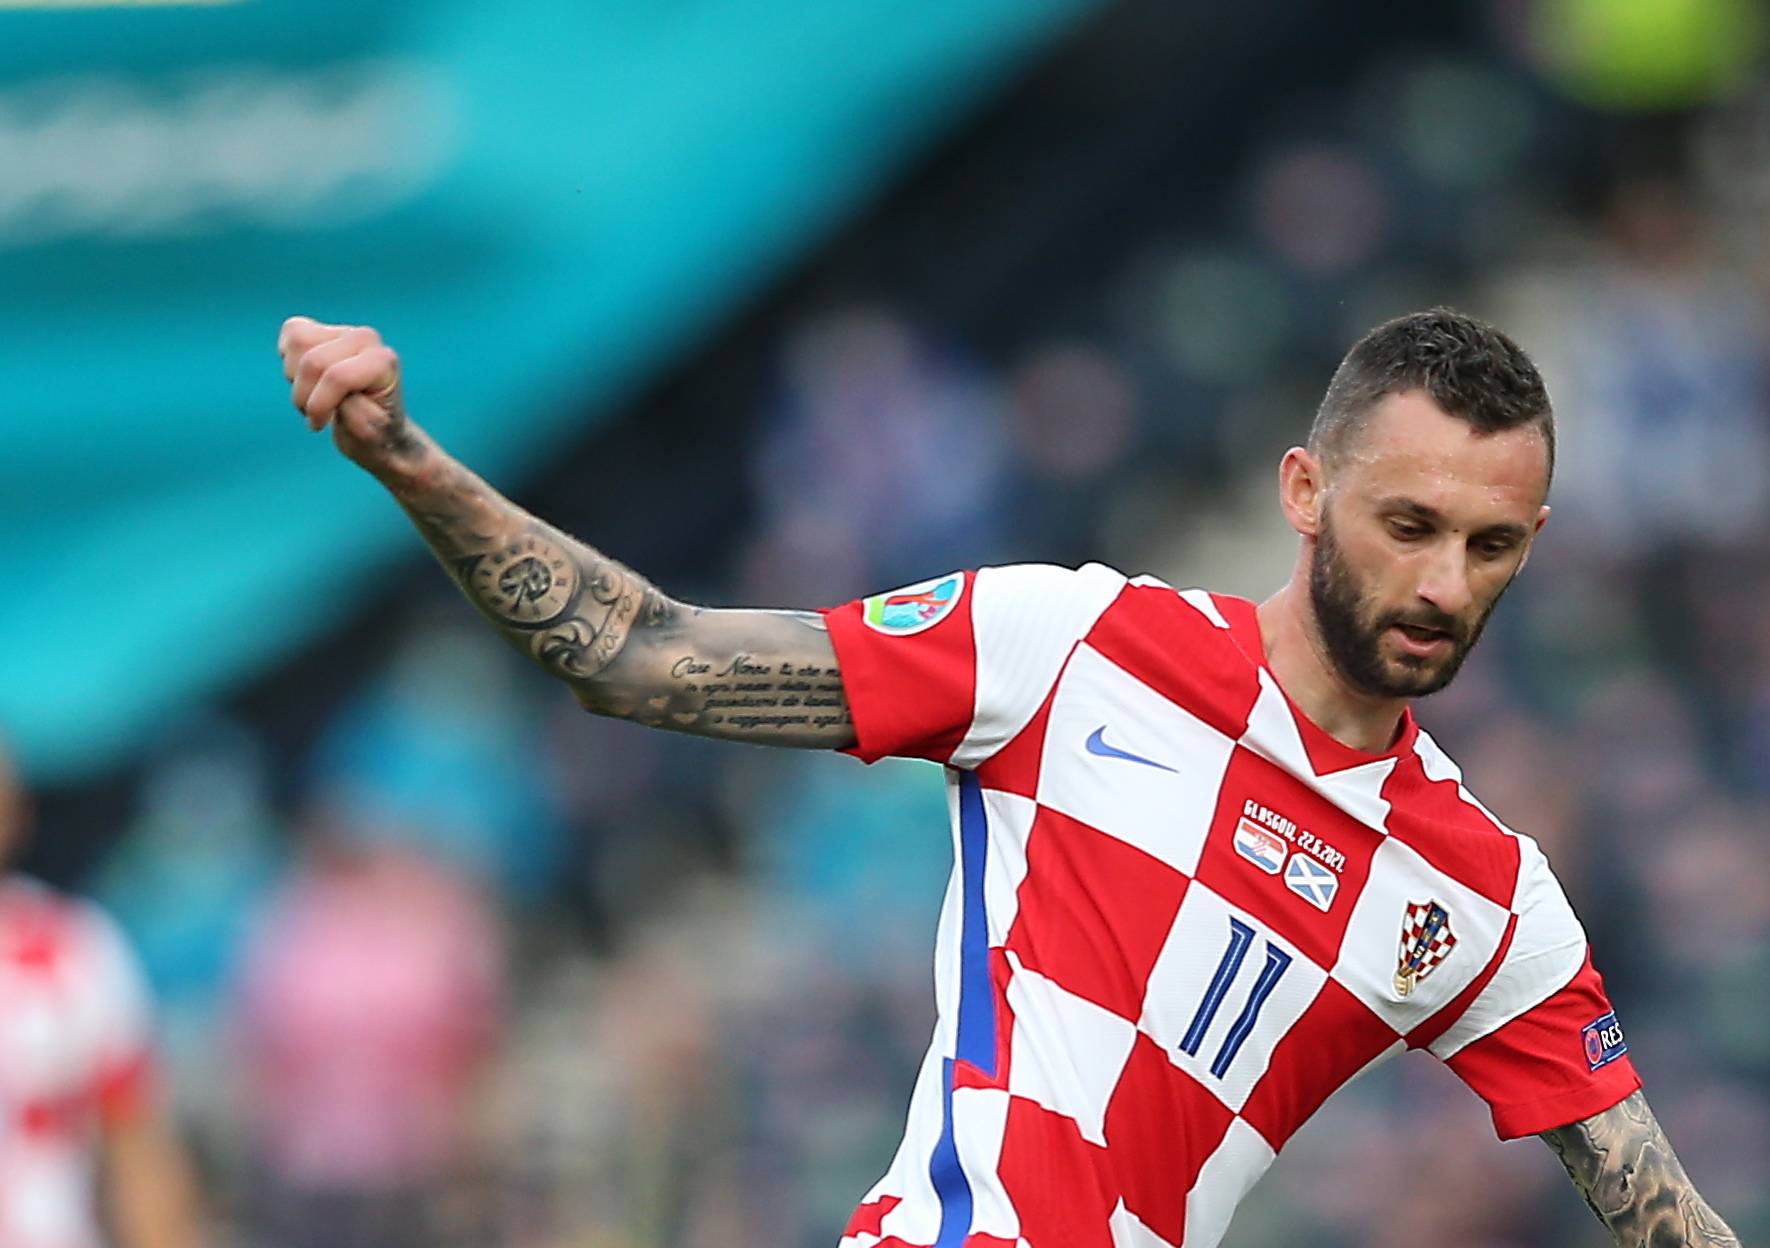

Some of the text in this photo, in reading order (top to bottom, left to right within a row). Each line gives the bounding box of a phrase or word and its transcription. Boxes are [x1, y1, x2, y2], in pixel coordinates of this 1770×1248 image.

[1243, 799, 1297, 842] GLASGOW,
[1179, 914, 1293, 1081] 11
[1600, 1022, 1624, 1050] RES
